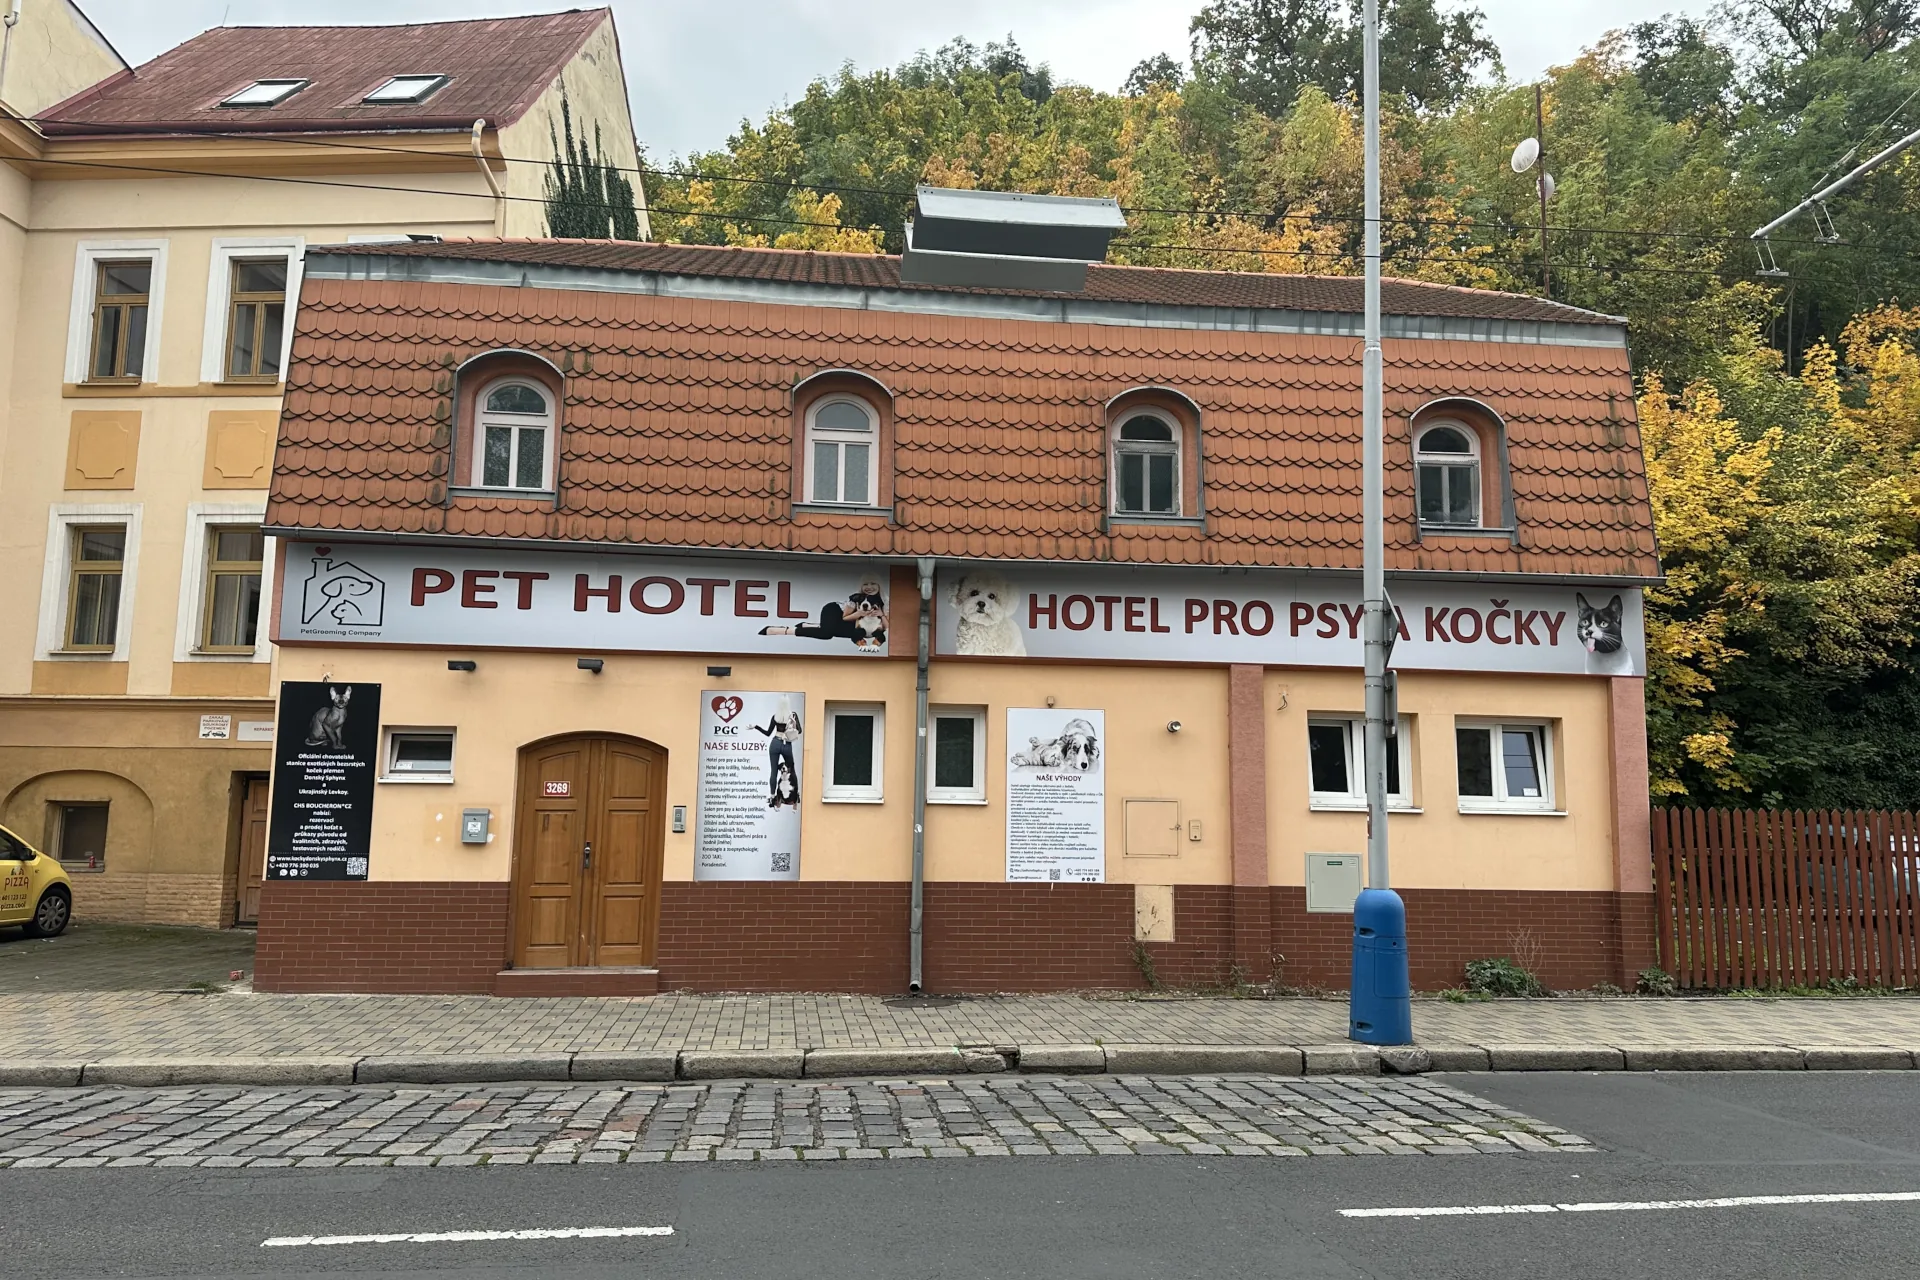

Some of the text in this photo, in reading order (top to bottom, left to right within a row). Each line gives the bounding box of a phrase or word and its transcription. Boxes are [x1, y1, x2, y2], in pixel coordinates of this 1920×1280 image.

[410, 567, 809, 619] PET HOTEL
[1028, 593, 1171, 633] HOTEL
[1184, 598, 1274, 637] PRO
[1289, 601, 1364, 639] PSY
[1424, 598, 1566, 646] KOČKY
[300, 628, 382, 637] PetGrooming Company
[713, 725, 739, 735] PGC
[704, 739, 729, 751] NAŠE
[1036, 773, 1082, 782] NAŠE VÝHODY
[546, 782, 568, 793] 3269
